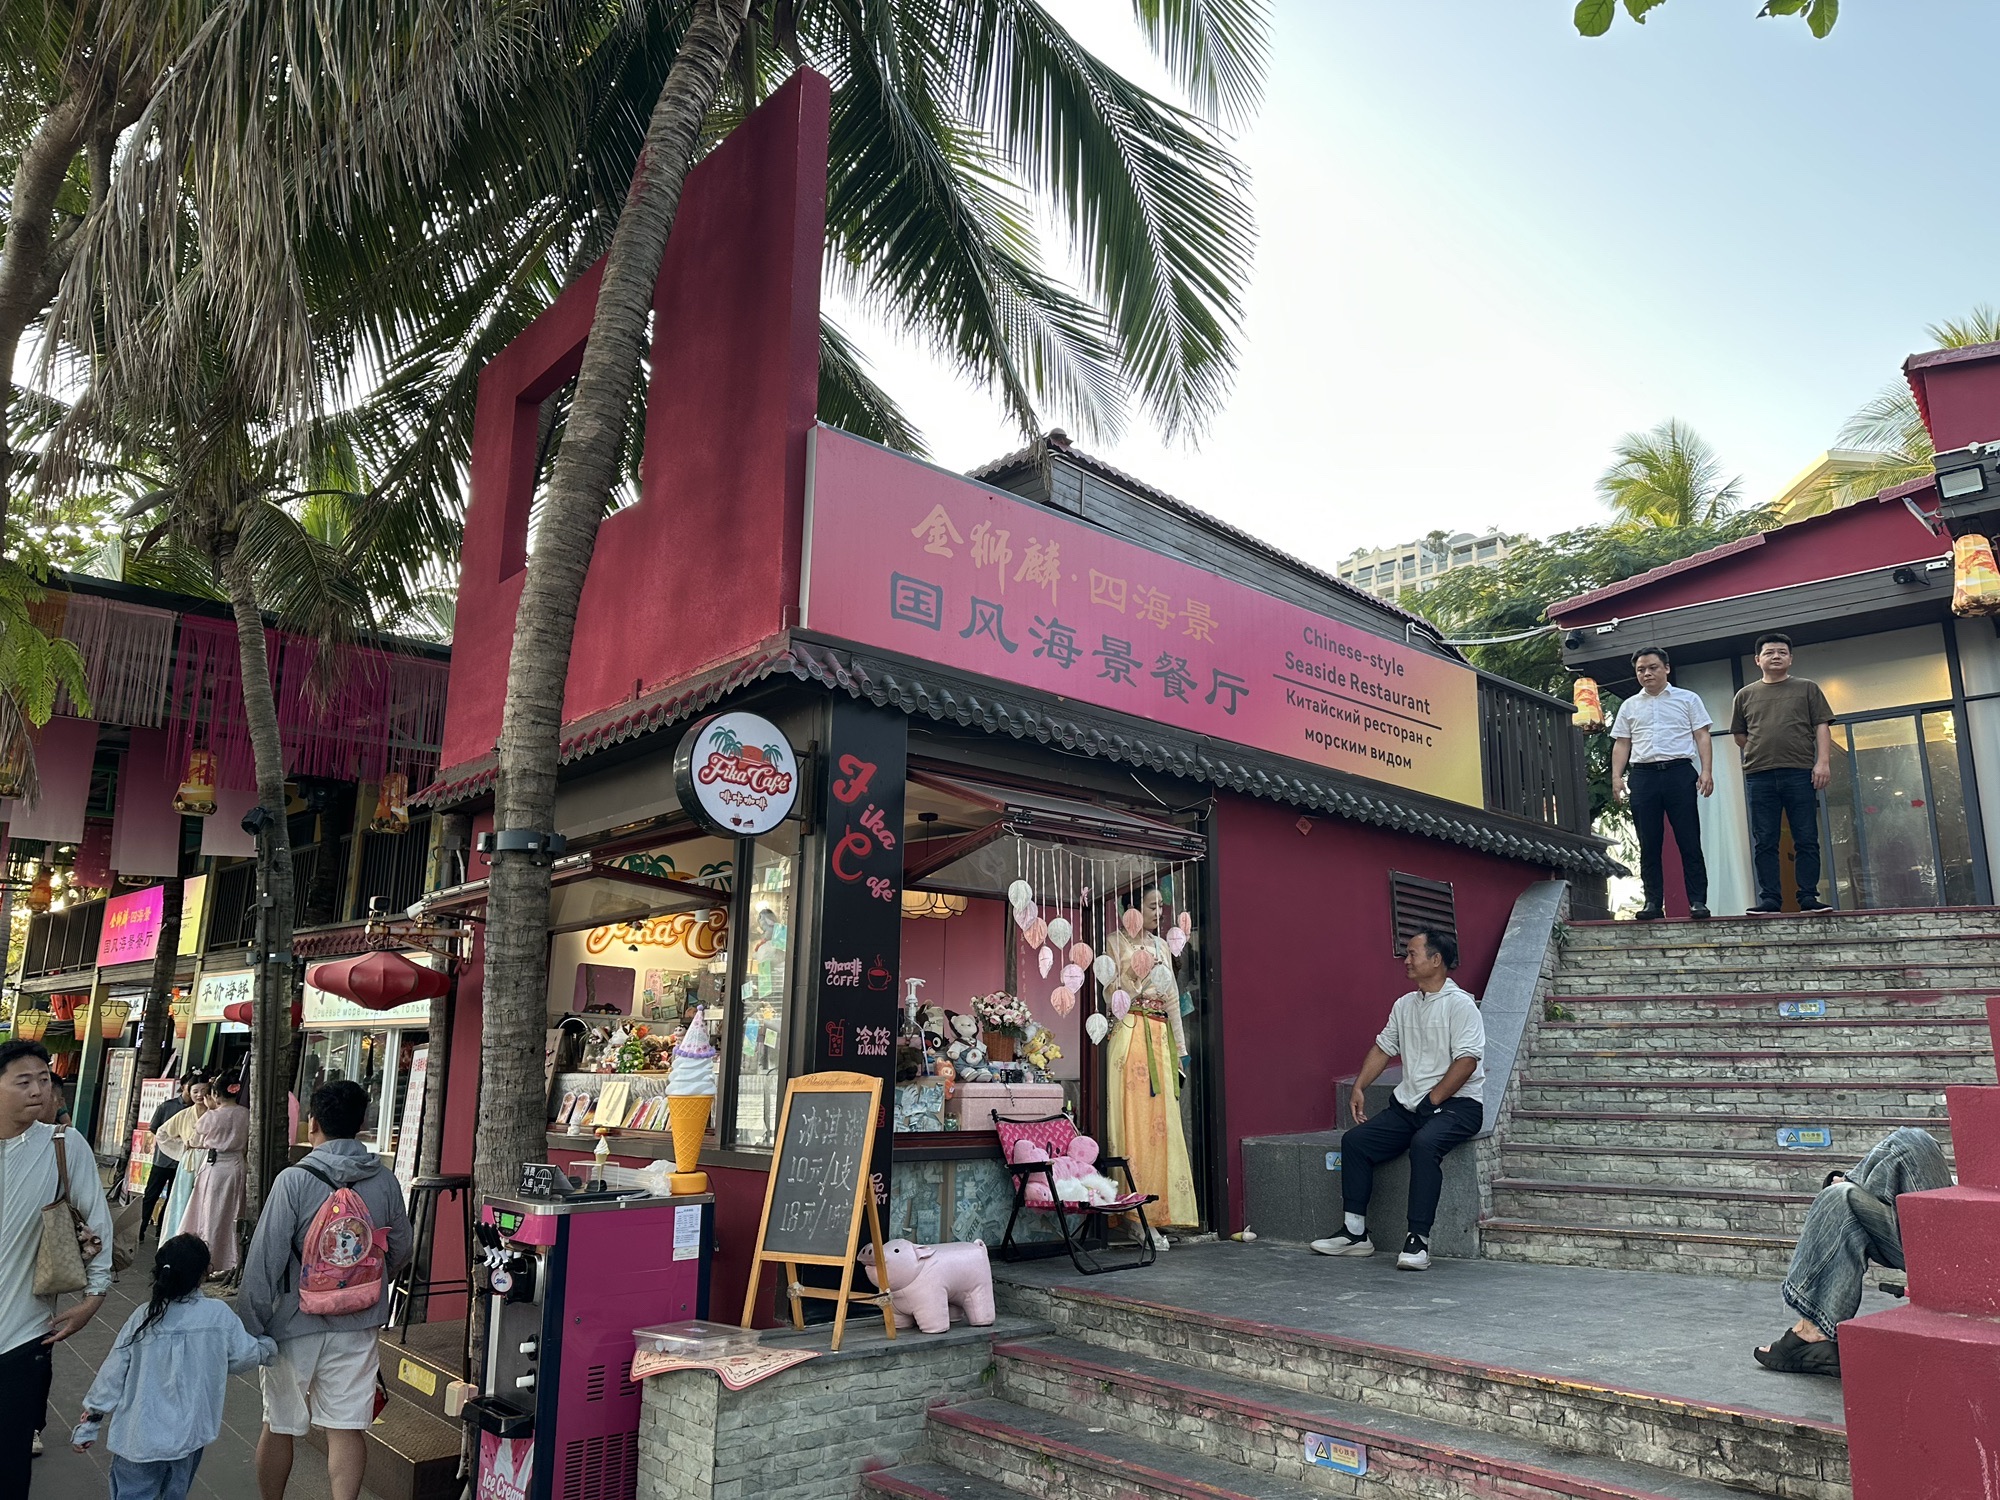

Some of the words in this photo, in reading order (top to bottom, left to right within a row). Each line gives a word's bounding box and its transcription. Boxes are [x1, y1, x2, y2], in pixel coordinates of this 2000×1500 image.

[890, 570, 1250, 716] 国风海景餐厅
[1303, 626, 1404, 677] Chinese-style
[1285, 651, 1346, 687] Seaside
[1350, 672, 1431, 715] Restaurant
[1286, 688, 1361, 726] Китайский
[1364, 716, 1423, 745] ресторан
[1305, 728, 1367, 756] морским
[1370, 746, 1412, 769] видом
[699, 753, 749, 785] Fika
[747, 765, 792, 795] Café
[824, 957, 862, 976] 咖啡
[826, 975, 860, 987] COFFE
[855, 1025, 891, 1046] 冷饮
[857, 1044, 888, 1056] DRINK
[798, 1106, 865, 1147] 冰淇淋
[482, 1467, 496, 1492] Ice
